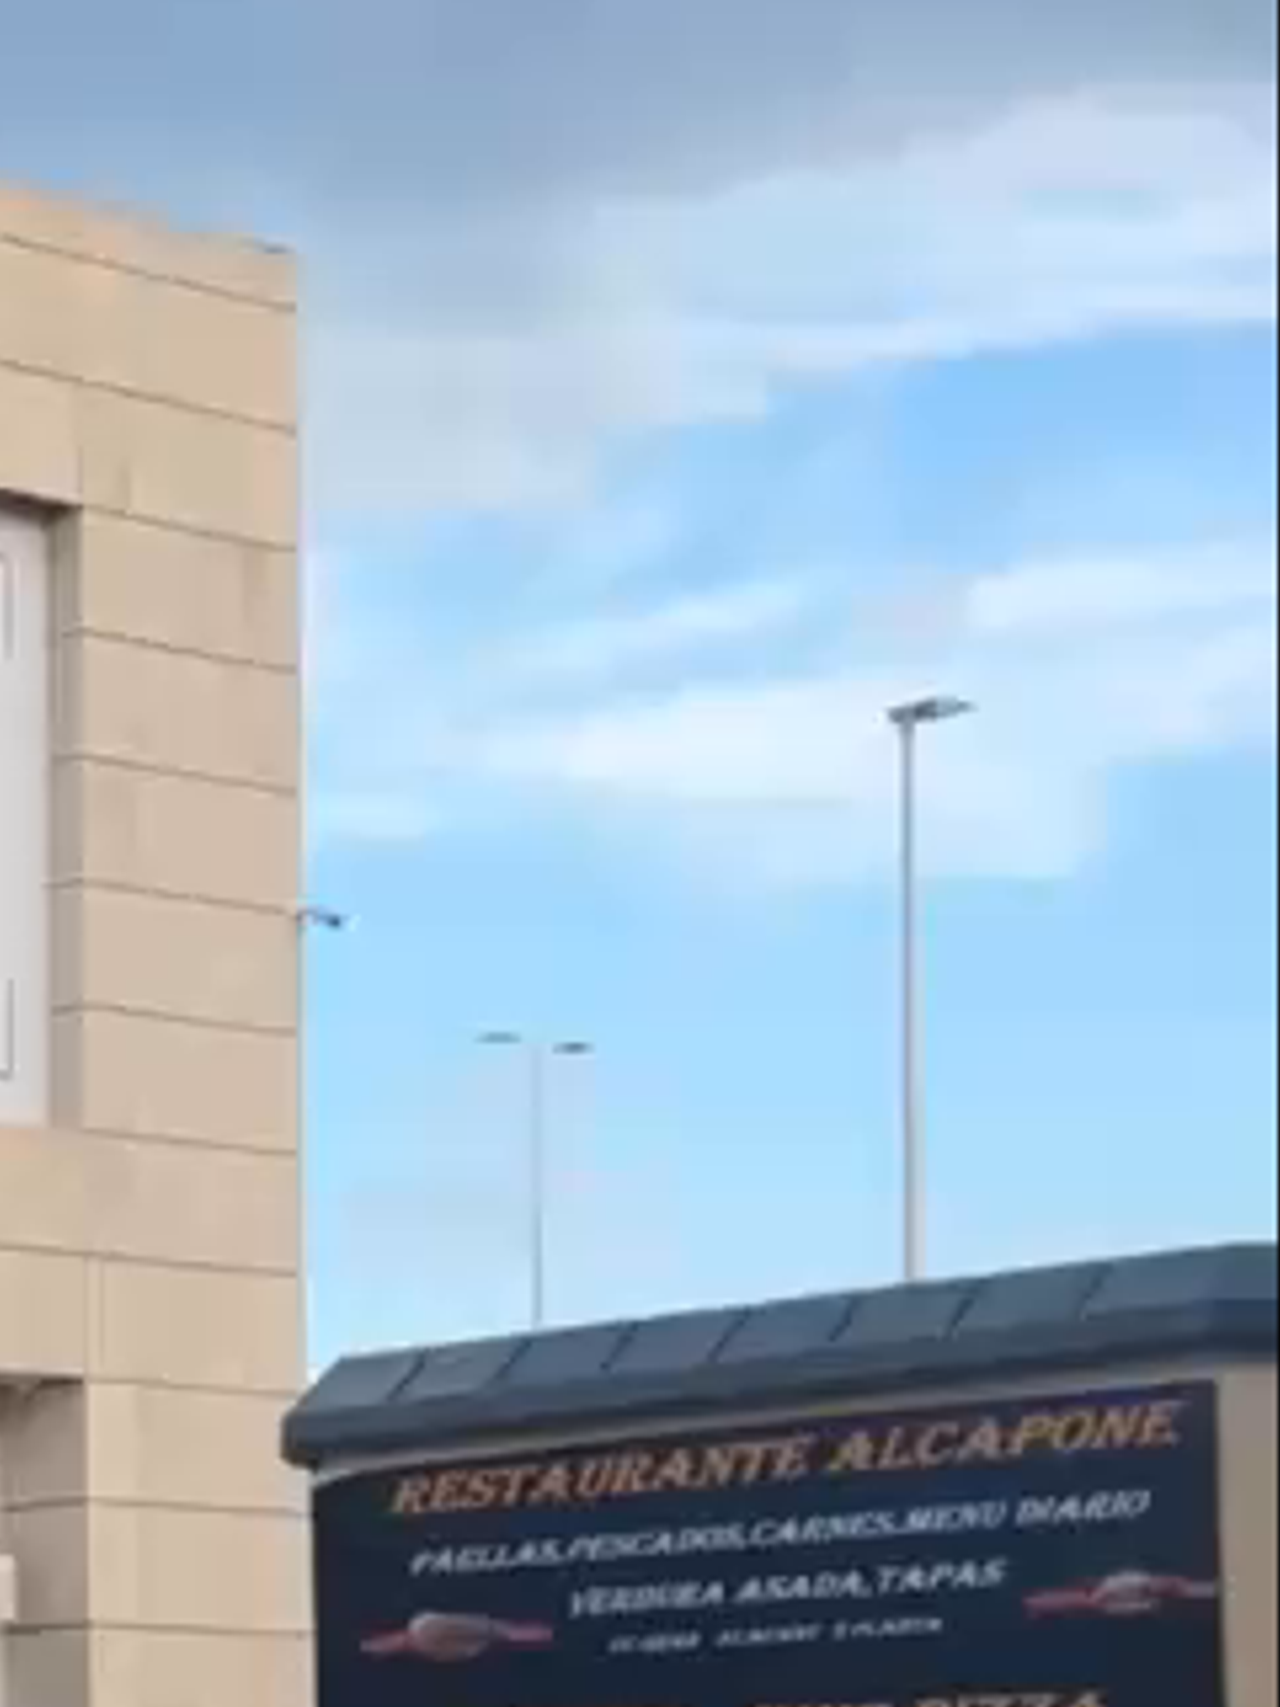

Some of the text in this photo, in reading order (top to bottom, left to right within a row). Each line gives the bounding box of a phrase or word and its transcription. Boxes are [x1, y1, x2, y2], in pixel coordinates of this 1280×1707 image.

[391, 1398, 1186, 1514] RESTAURANTE ALCAPONE
[1015, 1490, 1151, 1526] DIARIO
